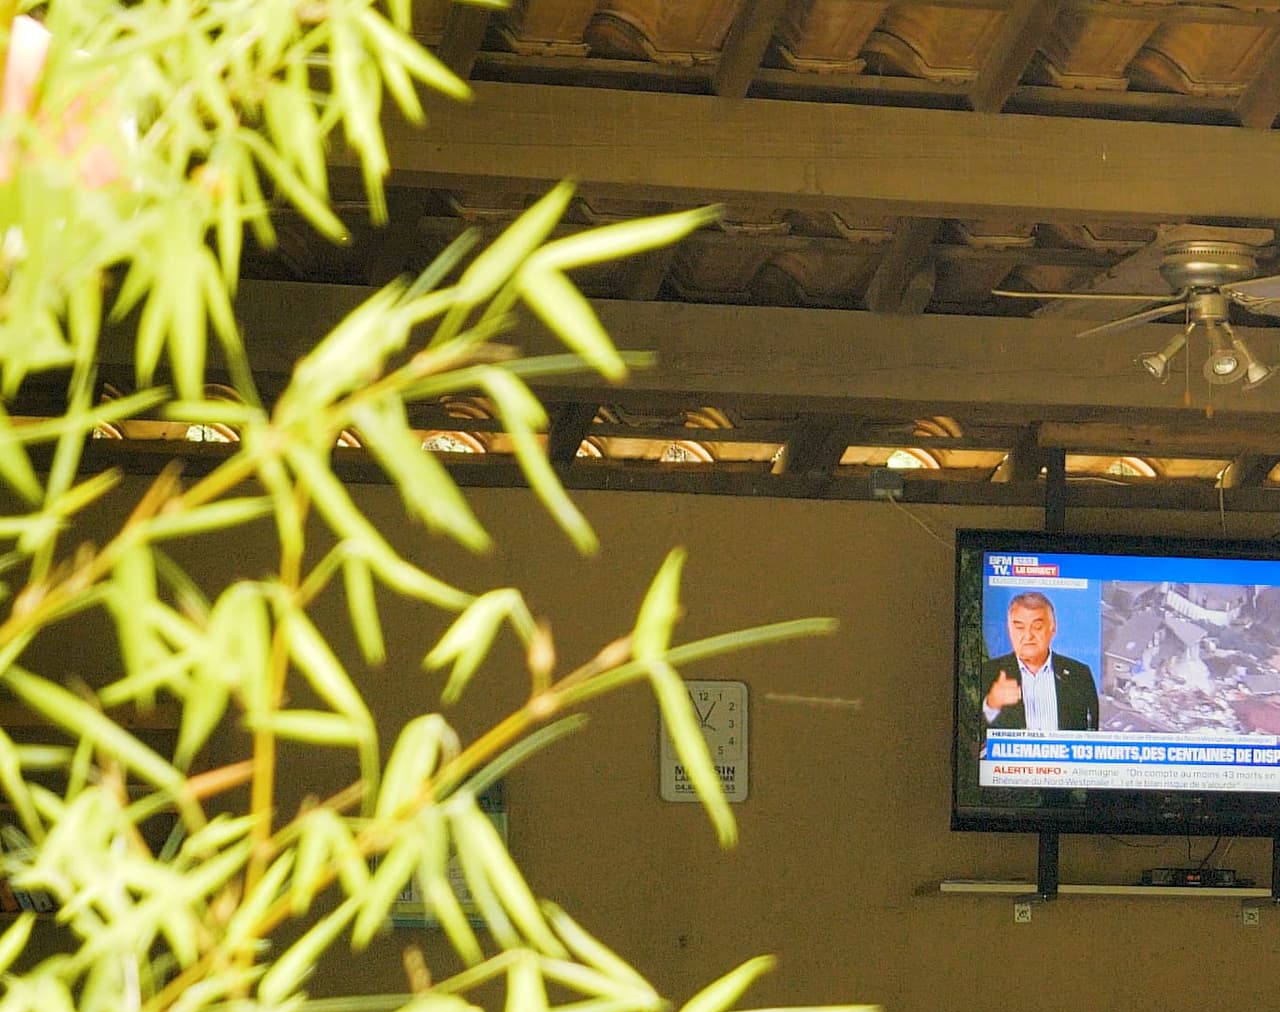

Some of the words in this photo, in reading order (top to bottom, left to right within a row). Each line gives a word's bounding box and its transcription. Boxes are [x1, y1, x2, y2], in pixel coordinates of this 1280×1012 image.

[1071, 744, 1093, 760] 103
[1166, 747, 1235, 762] CENTAINES
[1236, 748, 1252, 763] DE
[993, 765, 1034, 776] ALERTE
[1035, 766, 1062, 776] INFO
